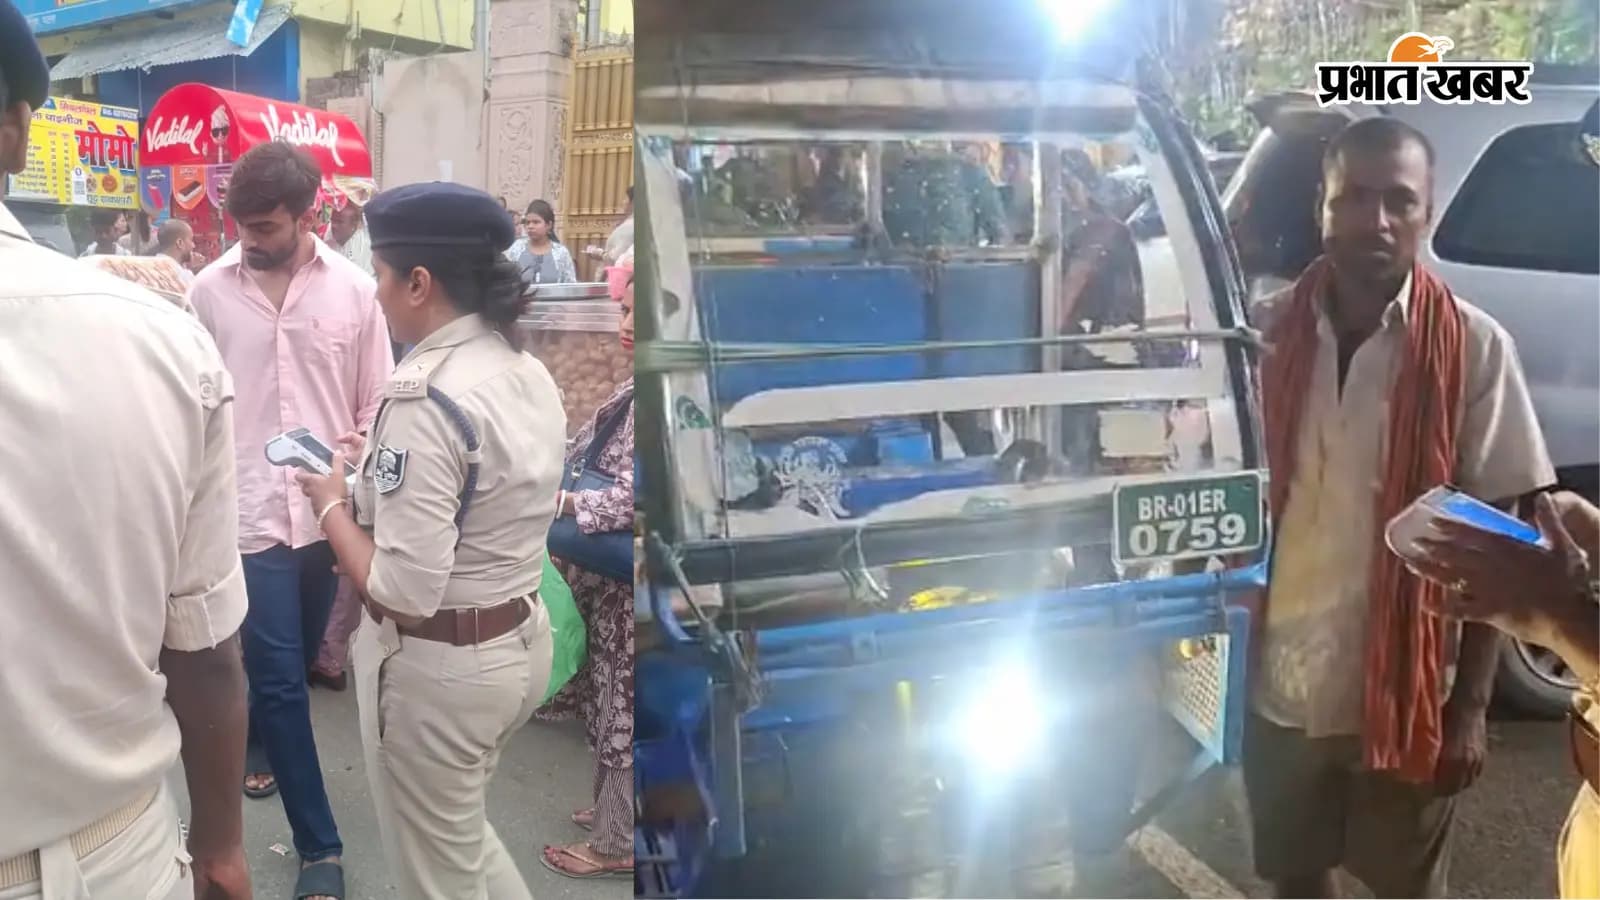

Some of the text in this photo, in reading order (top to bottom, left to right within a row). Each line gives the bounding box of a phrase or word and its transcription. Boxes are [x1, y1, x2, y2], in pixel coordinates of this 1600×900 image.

[74, 120, 137, 175] मोमो
[145, 114, 205, 155] Vadilal
[259, 103, 345, 168] Vadilal
[1137, 488, 1227, 522] BR-01ER
[1128, 512, 1247, 556] 0759
